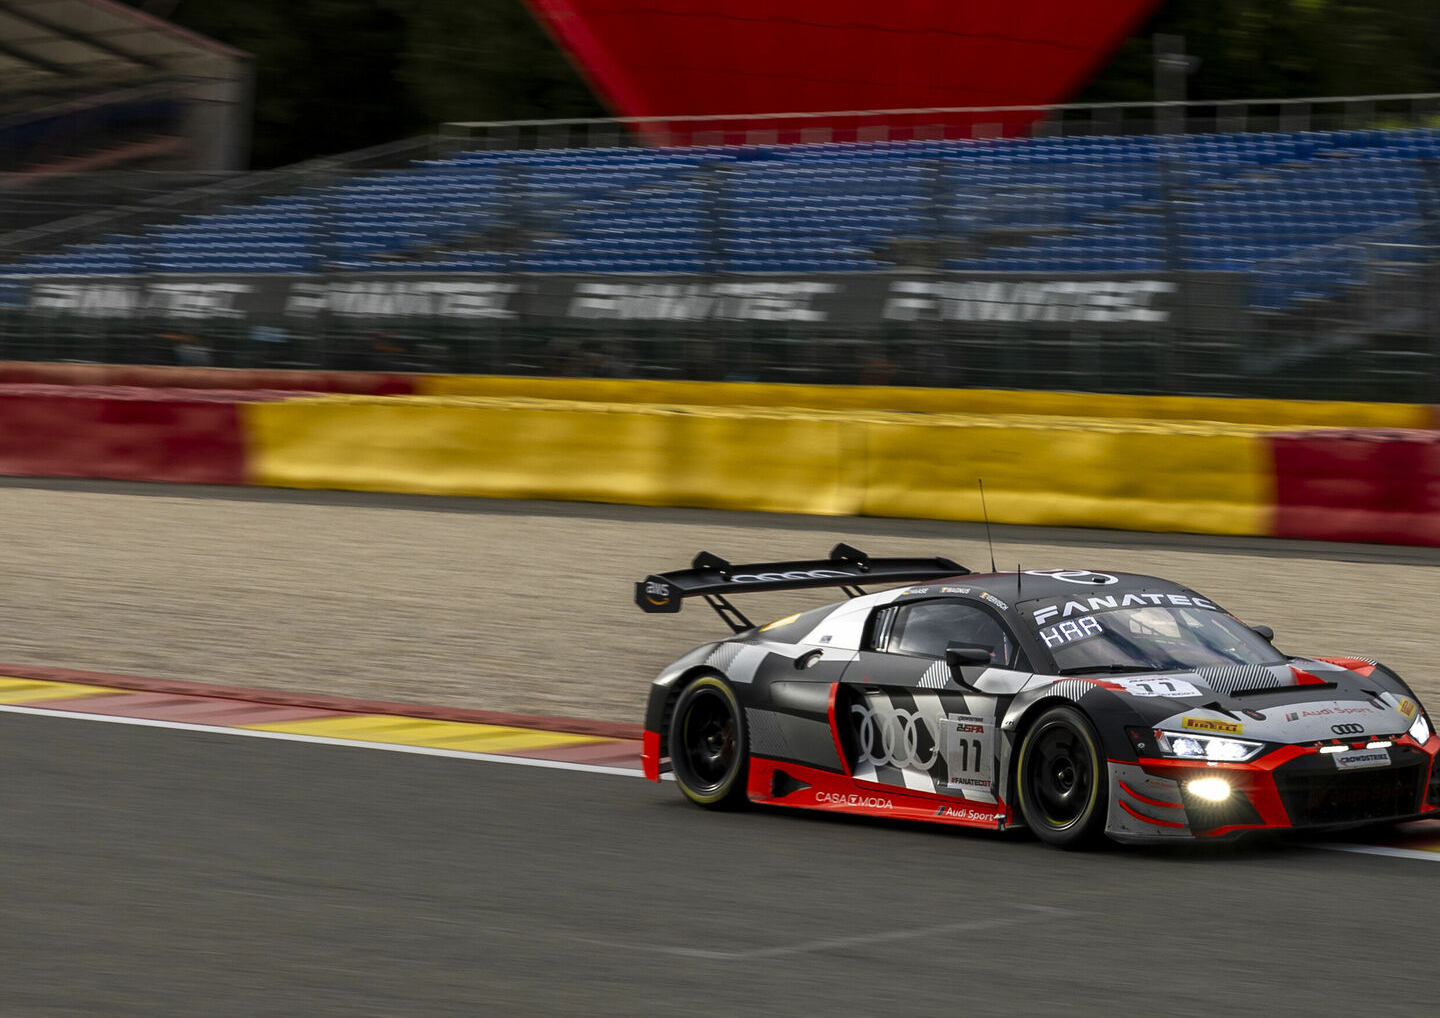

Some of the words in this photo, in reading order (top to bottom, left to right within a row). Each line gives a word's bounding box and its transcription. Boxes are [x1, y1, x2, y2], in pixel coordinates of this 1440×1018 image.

[1033, 593, 1217, 626] FANATEC
[1136, 682, 1176, 692] 11
[1302, 707, 1334, 718] Audi
[1335, 706, 1374, 716] Sport
[1187, 719, 1238, 732] PIRELLI
[960, 738, 982, 772] 11
[1340, 753, 1389, 764] CROWDSTRIKE
[946, 807, 967, 818] Audi
[967, 809, 994, 821] Sport
